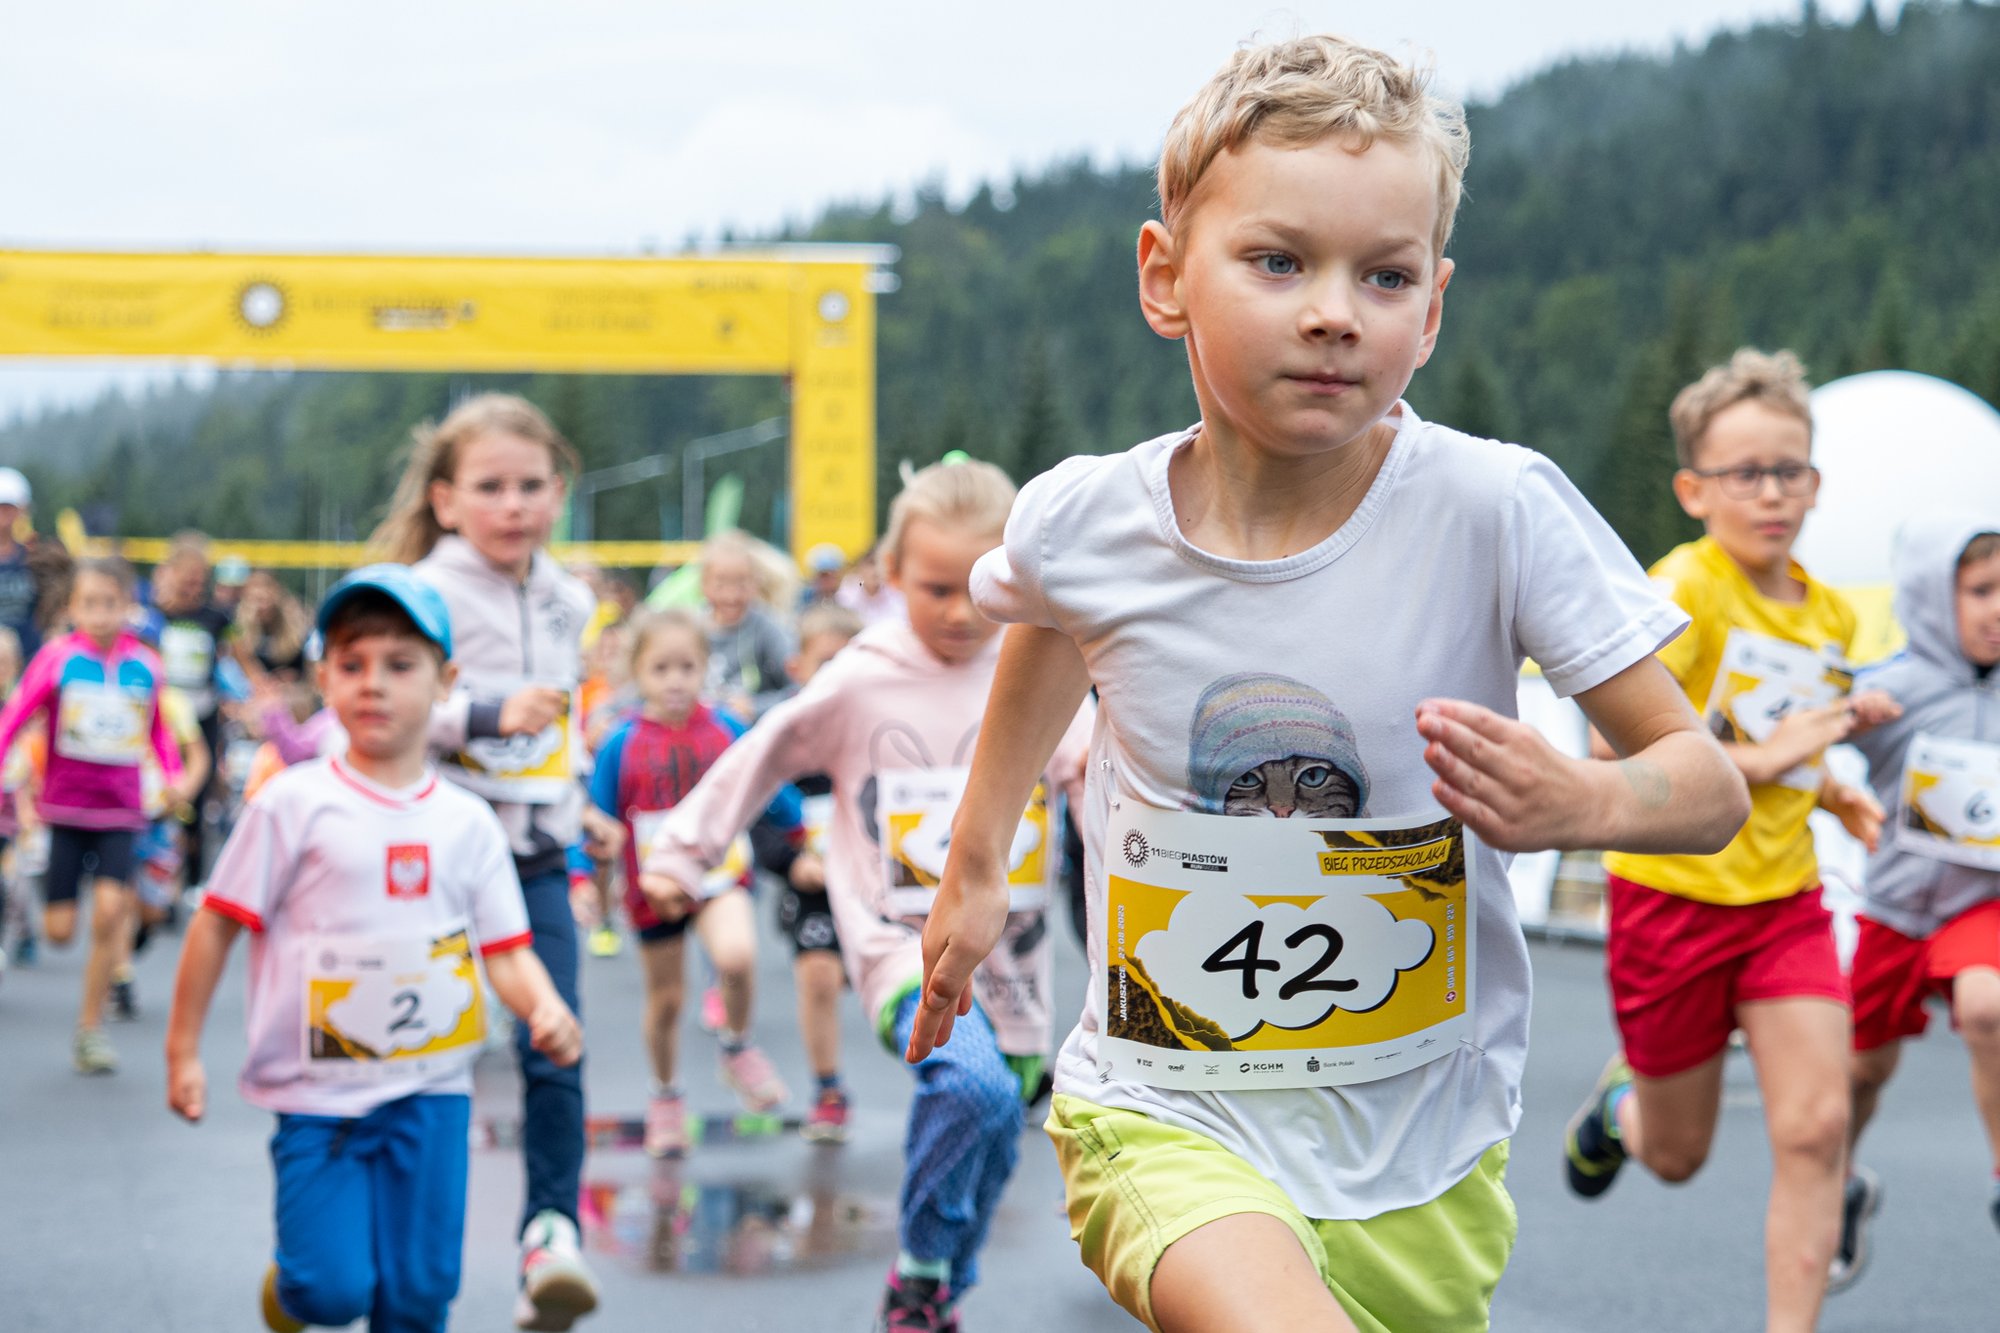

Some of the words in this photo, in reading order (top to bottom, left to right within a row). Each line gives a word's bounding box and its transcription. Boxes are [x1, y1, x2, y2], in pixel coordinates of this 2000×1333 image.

[1323, 857, 1349, 872] BIEG
[1352, 843, 1446, 871] PRZEDSZKOLAKA
[1201, 920, 1359, 1000] 42
[388, 989, 426, 1034] 2
[1253, 1063, 1284, 1071] KGHM
